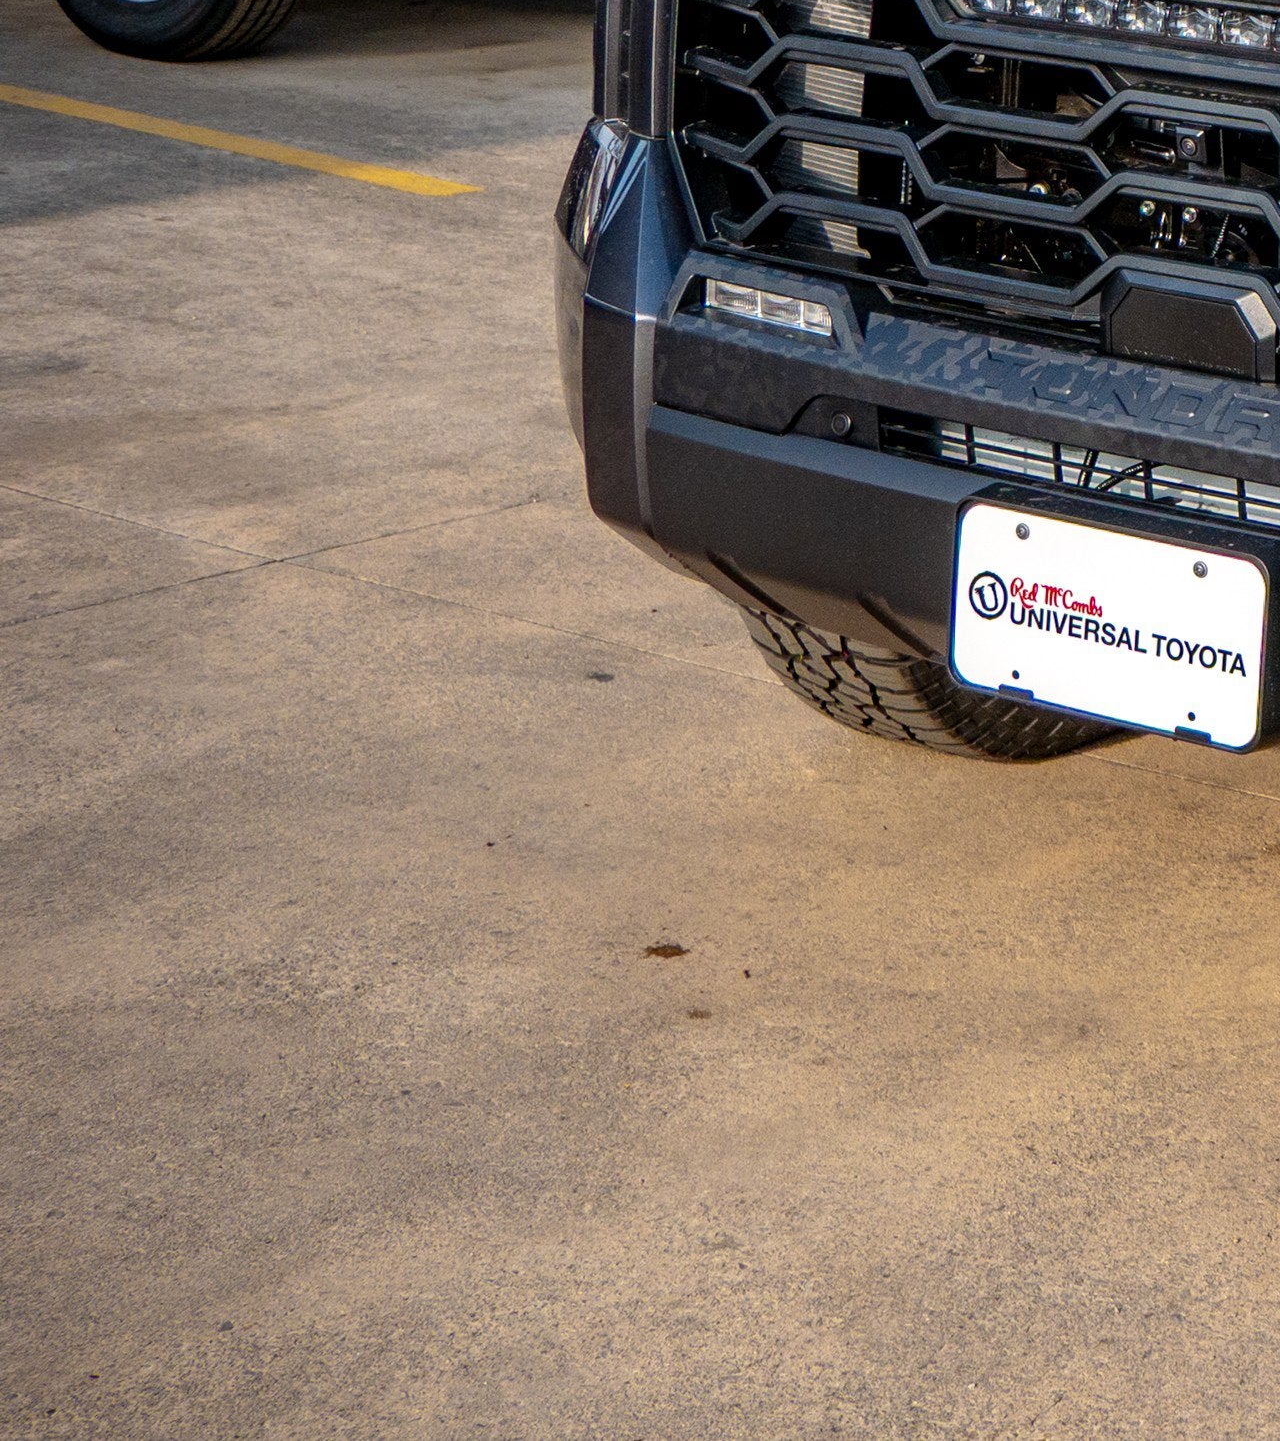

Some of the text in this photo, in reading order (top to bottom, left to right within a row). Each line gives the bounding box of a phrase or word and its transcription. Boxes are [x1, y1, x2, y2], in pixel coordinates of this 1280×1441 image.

[1010, 577, 1103, 618] Red McCombs
[1010, 602, 1247, 677] UNIVERSAL TOYOTA
